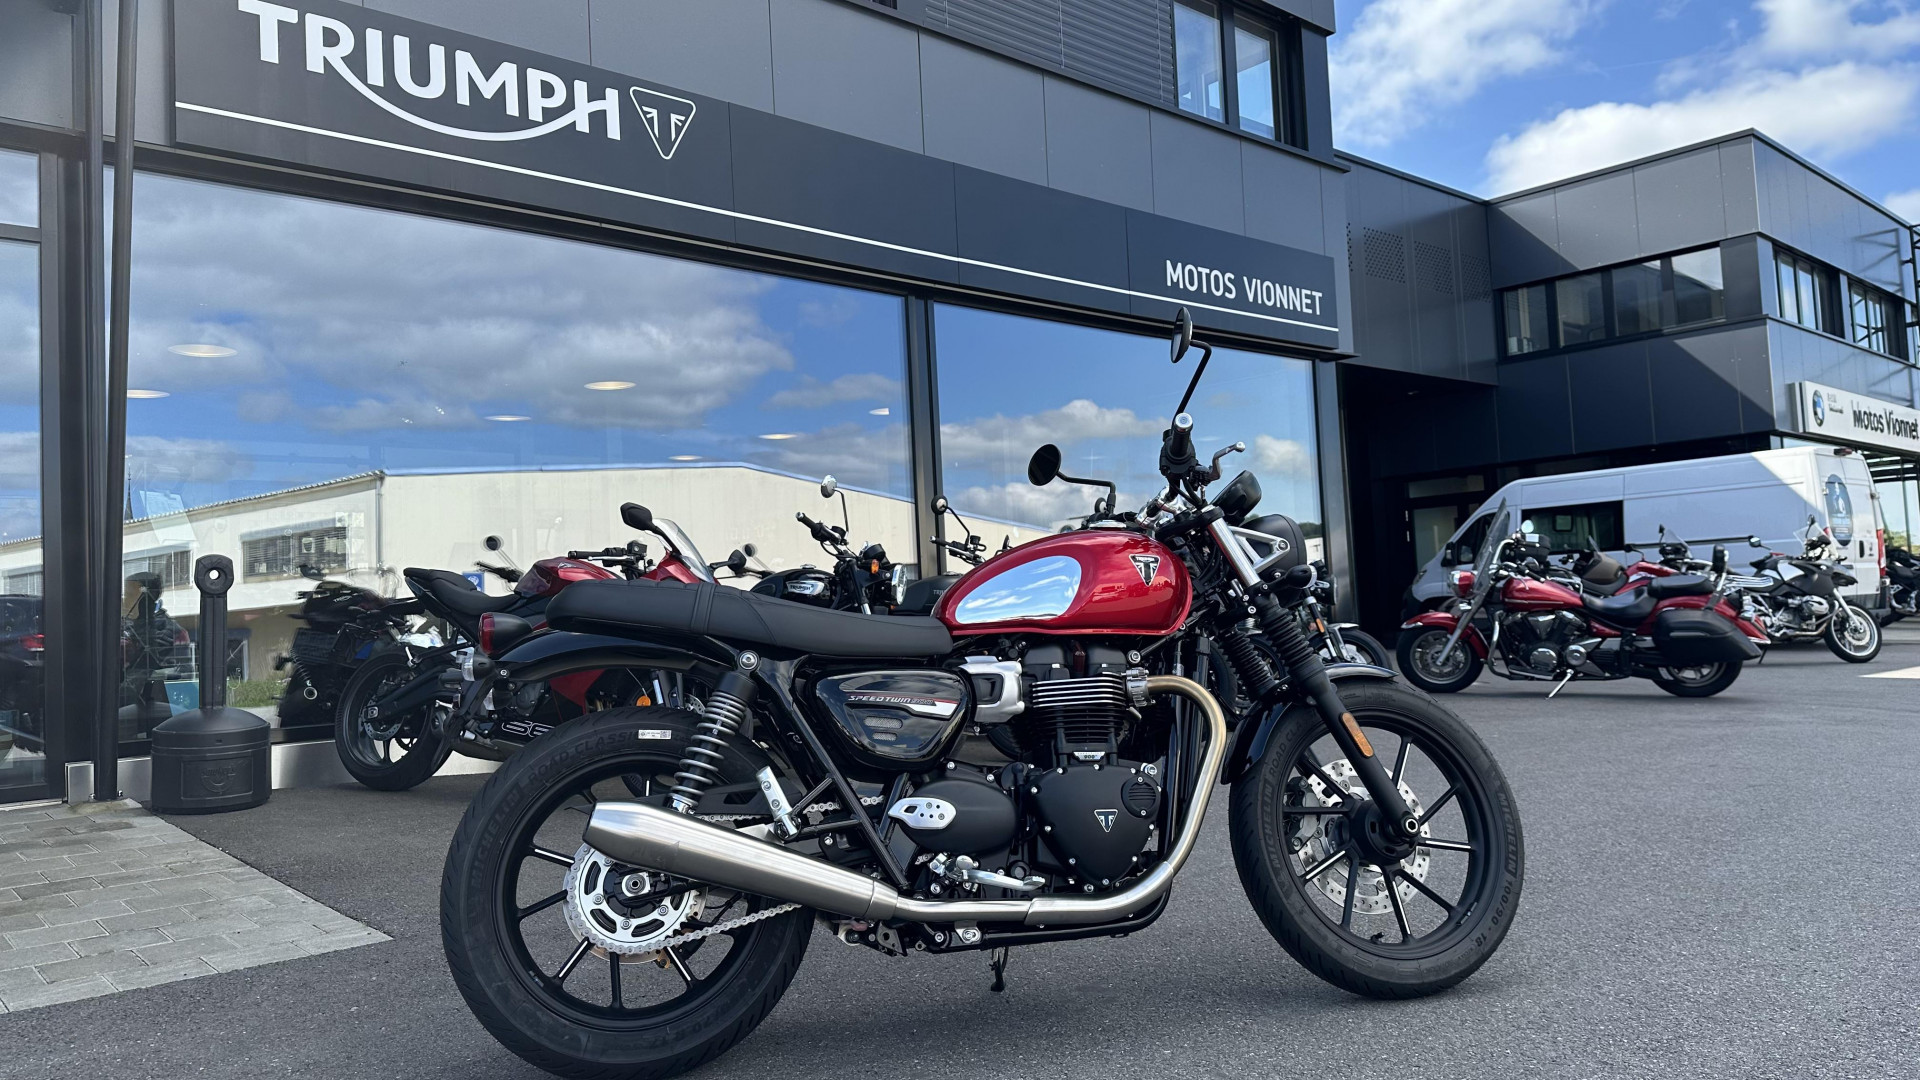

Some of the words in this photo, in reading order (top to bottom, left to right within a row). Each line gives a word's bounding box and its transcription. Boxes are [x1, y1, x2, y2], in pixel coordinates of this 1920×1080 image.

[238, 0, 621, 141] TRIUMPH
[1166, 260, 1236, 299] MOTOS
[1243, 276, 1322, 315] VIONNET
[1853, 410, 1884, 433] Motos
[1885, 409, 1919, 440] Vionnet
[575, 731, 640, 753] CLASSI
[1498, 793, 1517, 874] MICHELIN
